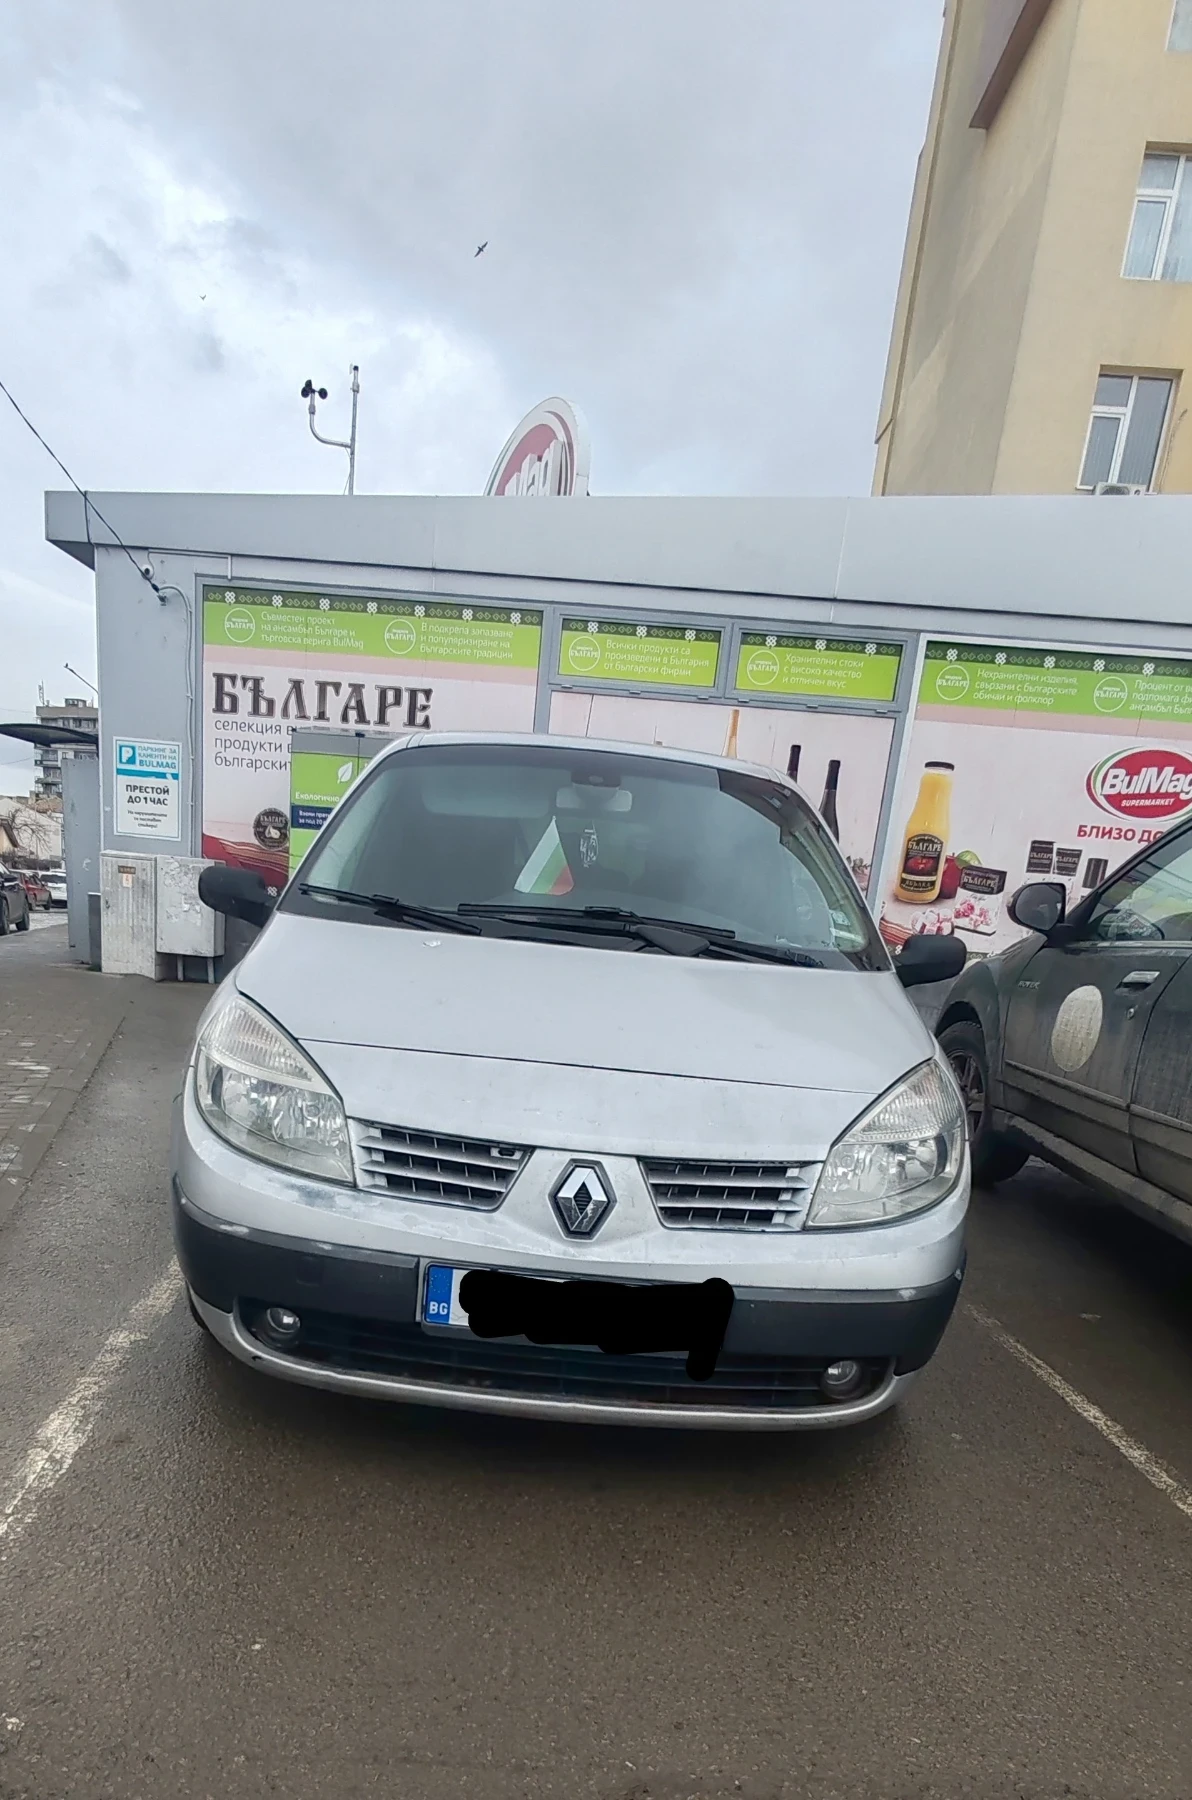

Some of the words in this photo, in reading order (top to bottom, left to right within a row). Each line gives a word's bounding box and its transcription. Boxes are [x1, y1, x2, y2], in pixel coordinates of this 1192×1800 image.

[261, 611, 305, 622] Съвместен
[307, 616, 335, 625] проект
[272, 624, 313, 634] ансамбъл
[315, 628, 347, 638] Българе
[421, 623, 427, 632] В
[429, 624, 469, 636] подкрепа
[471, 629, 514, 639] запазване
[261, 634, 302, 644] търговска
[303, 638, 331, 648] верига
[333, 638, 364, 650] BulMag
[428, 635, 499, 649] популяризиране
[606, 639, 637, 650] Всички
[638, 644, 680, 656] продукти
[420, 644, 472, 657] българските
[473, 649, 513, 660] традиции
[605, 652, 661, 664] произведени
[670, 656, 710, 668] България
[785, 654, 838, 666] Хранителни
[839, 659, 864, 668] стоки
[603, 662, 613, 670] от
[615, 662, 659, 674] български
[660, 665, 691, 677] фирми
[783, 666, 789, 674] с
[791, 666, 821, 676] високо
[823, 670, 862, 679] качество
[978, 669, 1040, 682] Нехранителни
[790, 677, 826, 686] отличен
[827, 680, 847, 689] вкус
[975, 681, 1015, 692] свързани
[1023, 682, 1077, 695] българските
[1135, 679, 1172, 691] Процент
[1173, 684, 1183, 692] от
[212, 672, 433, 730] БЪЛГАРЕ
[973, 691, 1005, 701] обичаи
[1015, 693, 1054, 705] фолклор
[1132, 693, 1179, 703] подпомага
[1129, 703, 1172, 713] ансамбъл
[1173, 704, 1192, 714] Бъл
[214, 719, 282, 737] селекция
[138, 745, 167, 753] ПАРКИНГ
[214, 737, 283, 755] продукти
[139, 759, 177, 769] BULMAG
[125, 784, 170, 796] ПРЕСТОЙ
[295, 791, 340, 803] Екологично
[127, 795, 141, 804] ДО
[143, 796, 148, 805] 1
[150, 797, 168, 806] ЧАС
[1121, 798, 1176, 807] SUPERMARKET
[316, 811, 330, 819] прат
[1077, 824, 1136, 842] БЛИЗО
[908, 841, 942, 852] БЪЛГАРЕ
[429, 1301, 448, 1315] BG
